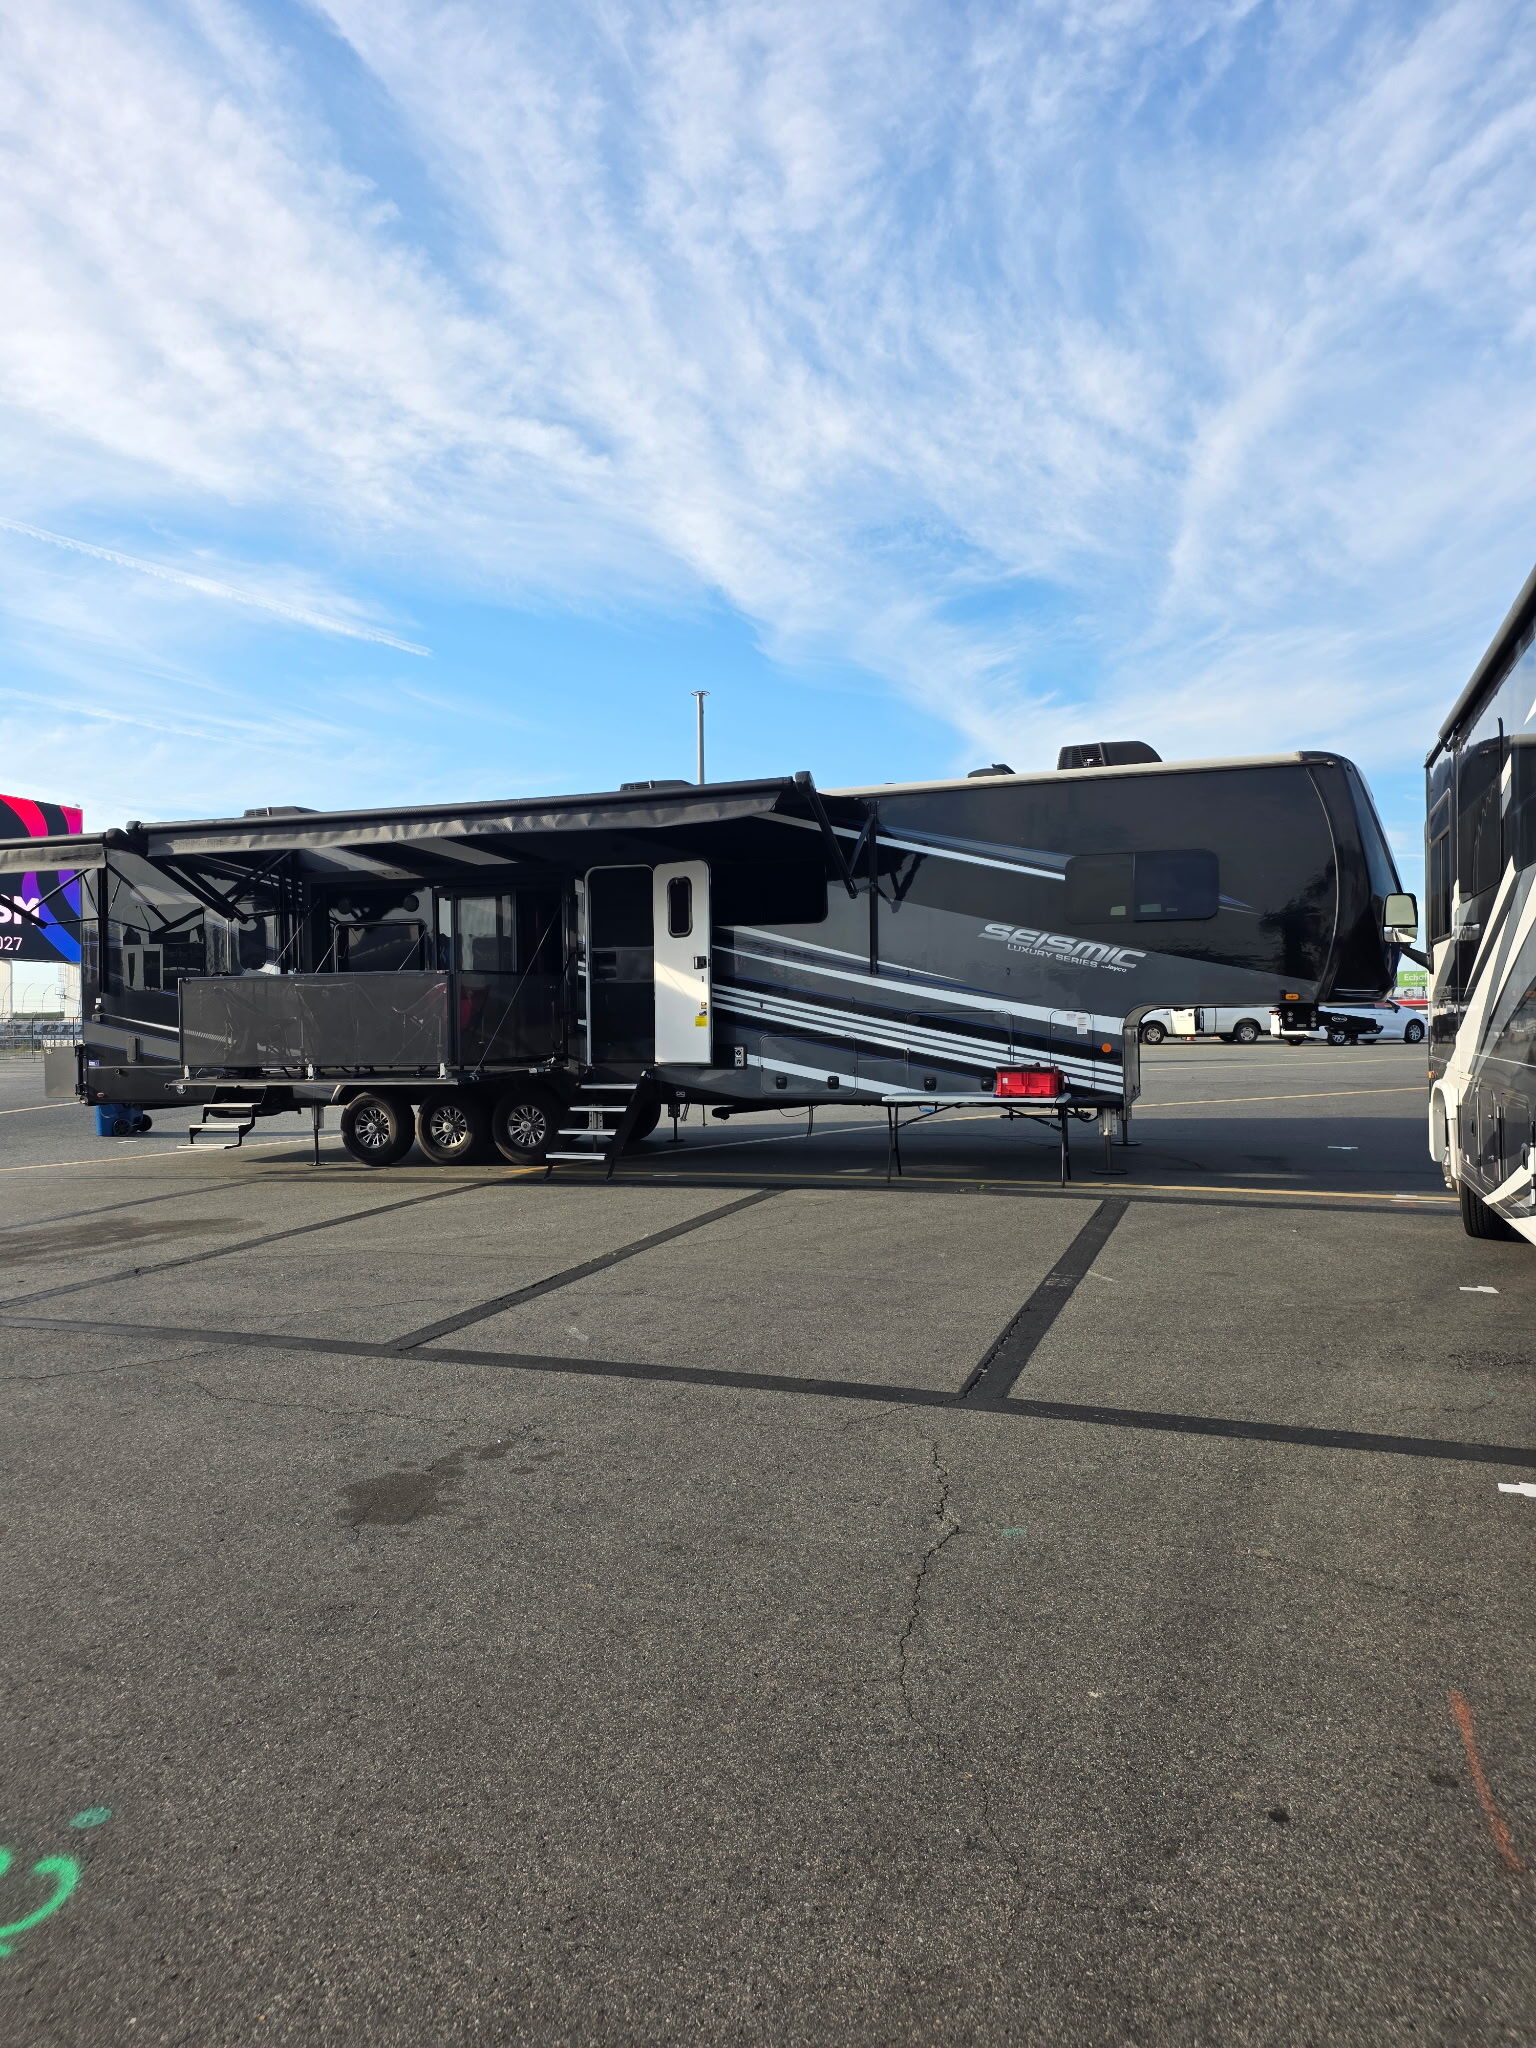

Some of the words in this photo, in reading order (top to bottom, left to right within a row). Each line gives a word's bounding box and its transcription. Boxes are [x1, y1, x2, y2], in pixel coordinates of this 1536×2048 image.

[977, 923, 1147, 969] SEISMIC
[1007, 943, 1053, 958] LUXURY
[1055, 953, 1098, 968] SERIES
